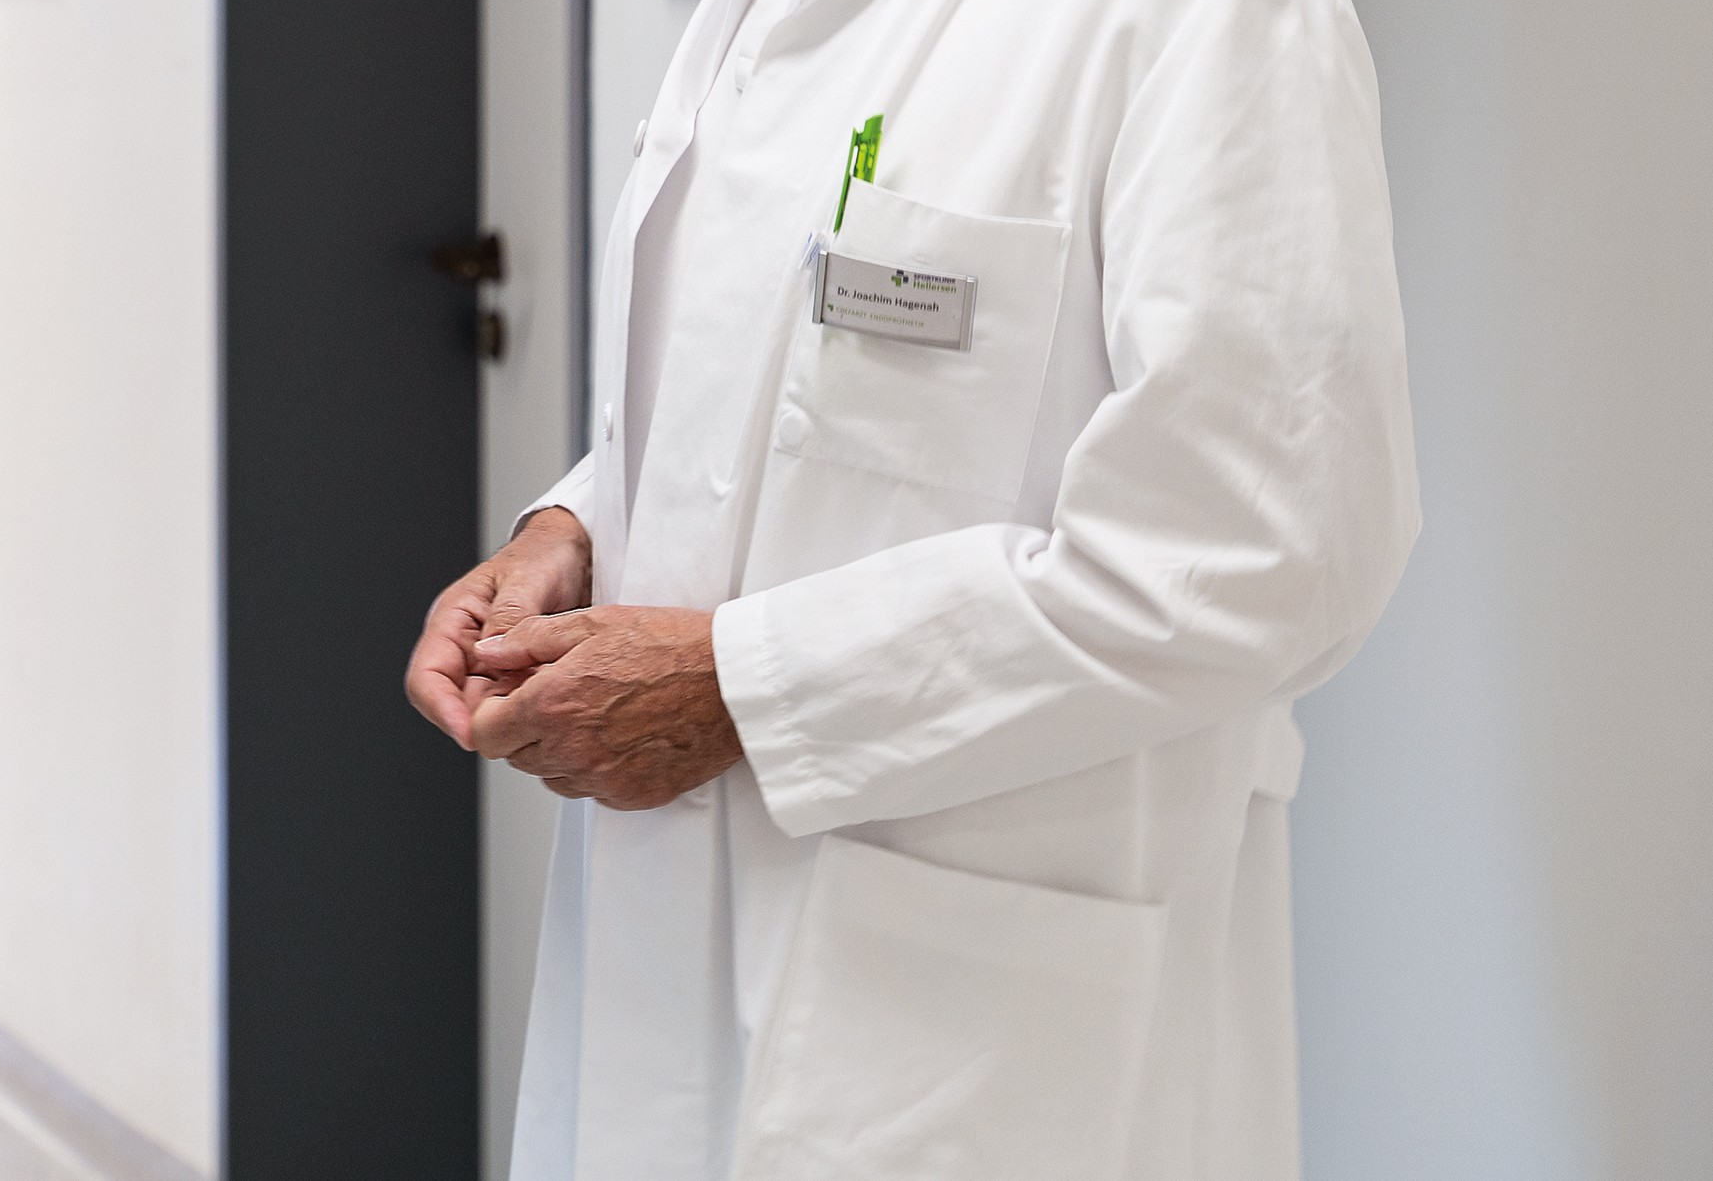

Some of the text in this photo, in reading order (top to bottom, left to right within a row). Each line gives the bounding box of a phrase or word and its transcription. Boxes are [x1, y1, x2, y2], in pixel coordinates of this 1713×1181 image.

[913, 281, 957, 294] Hellersen
[837, 286, 940, 312] Dr. Joachim Hagenah
